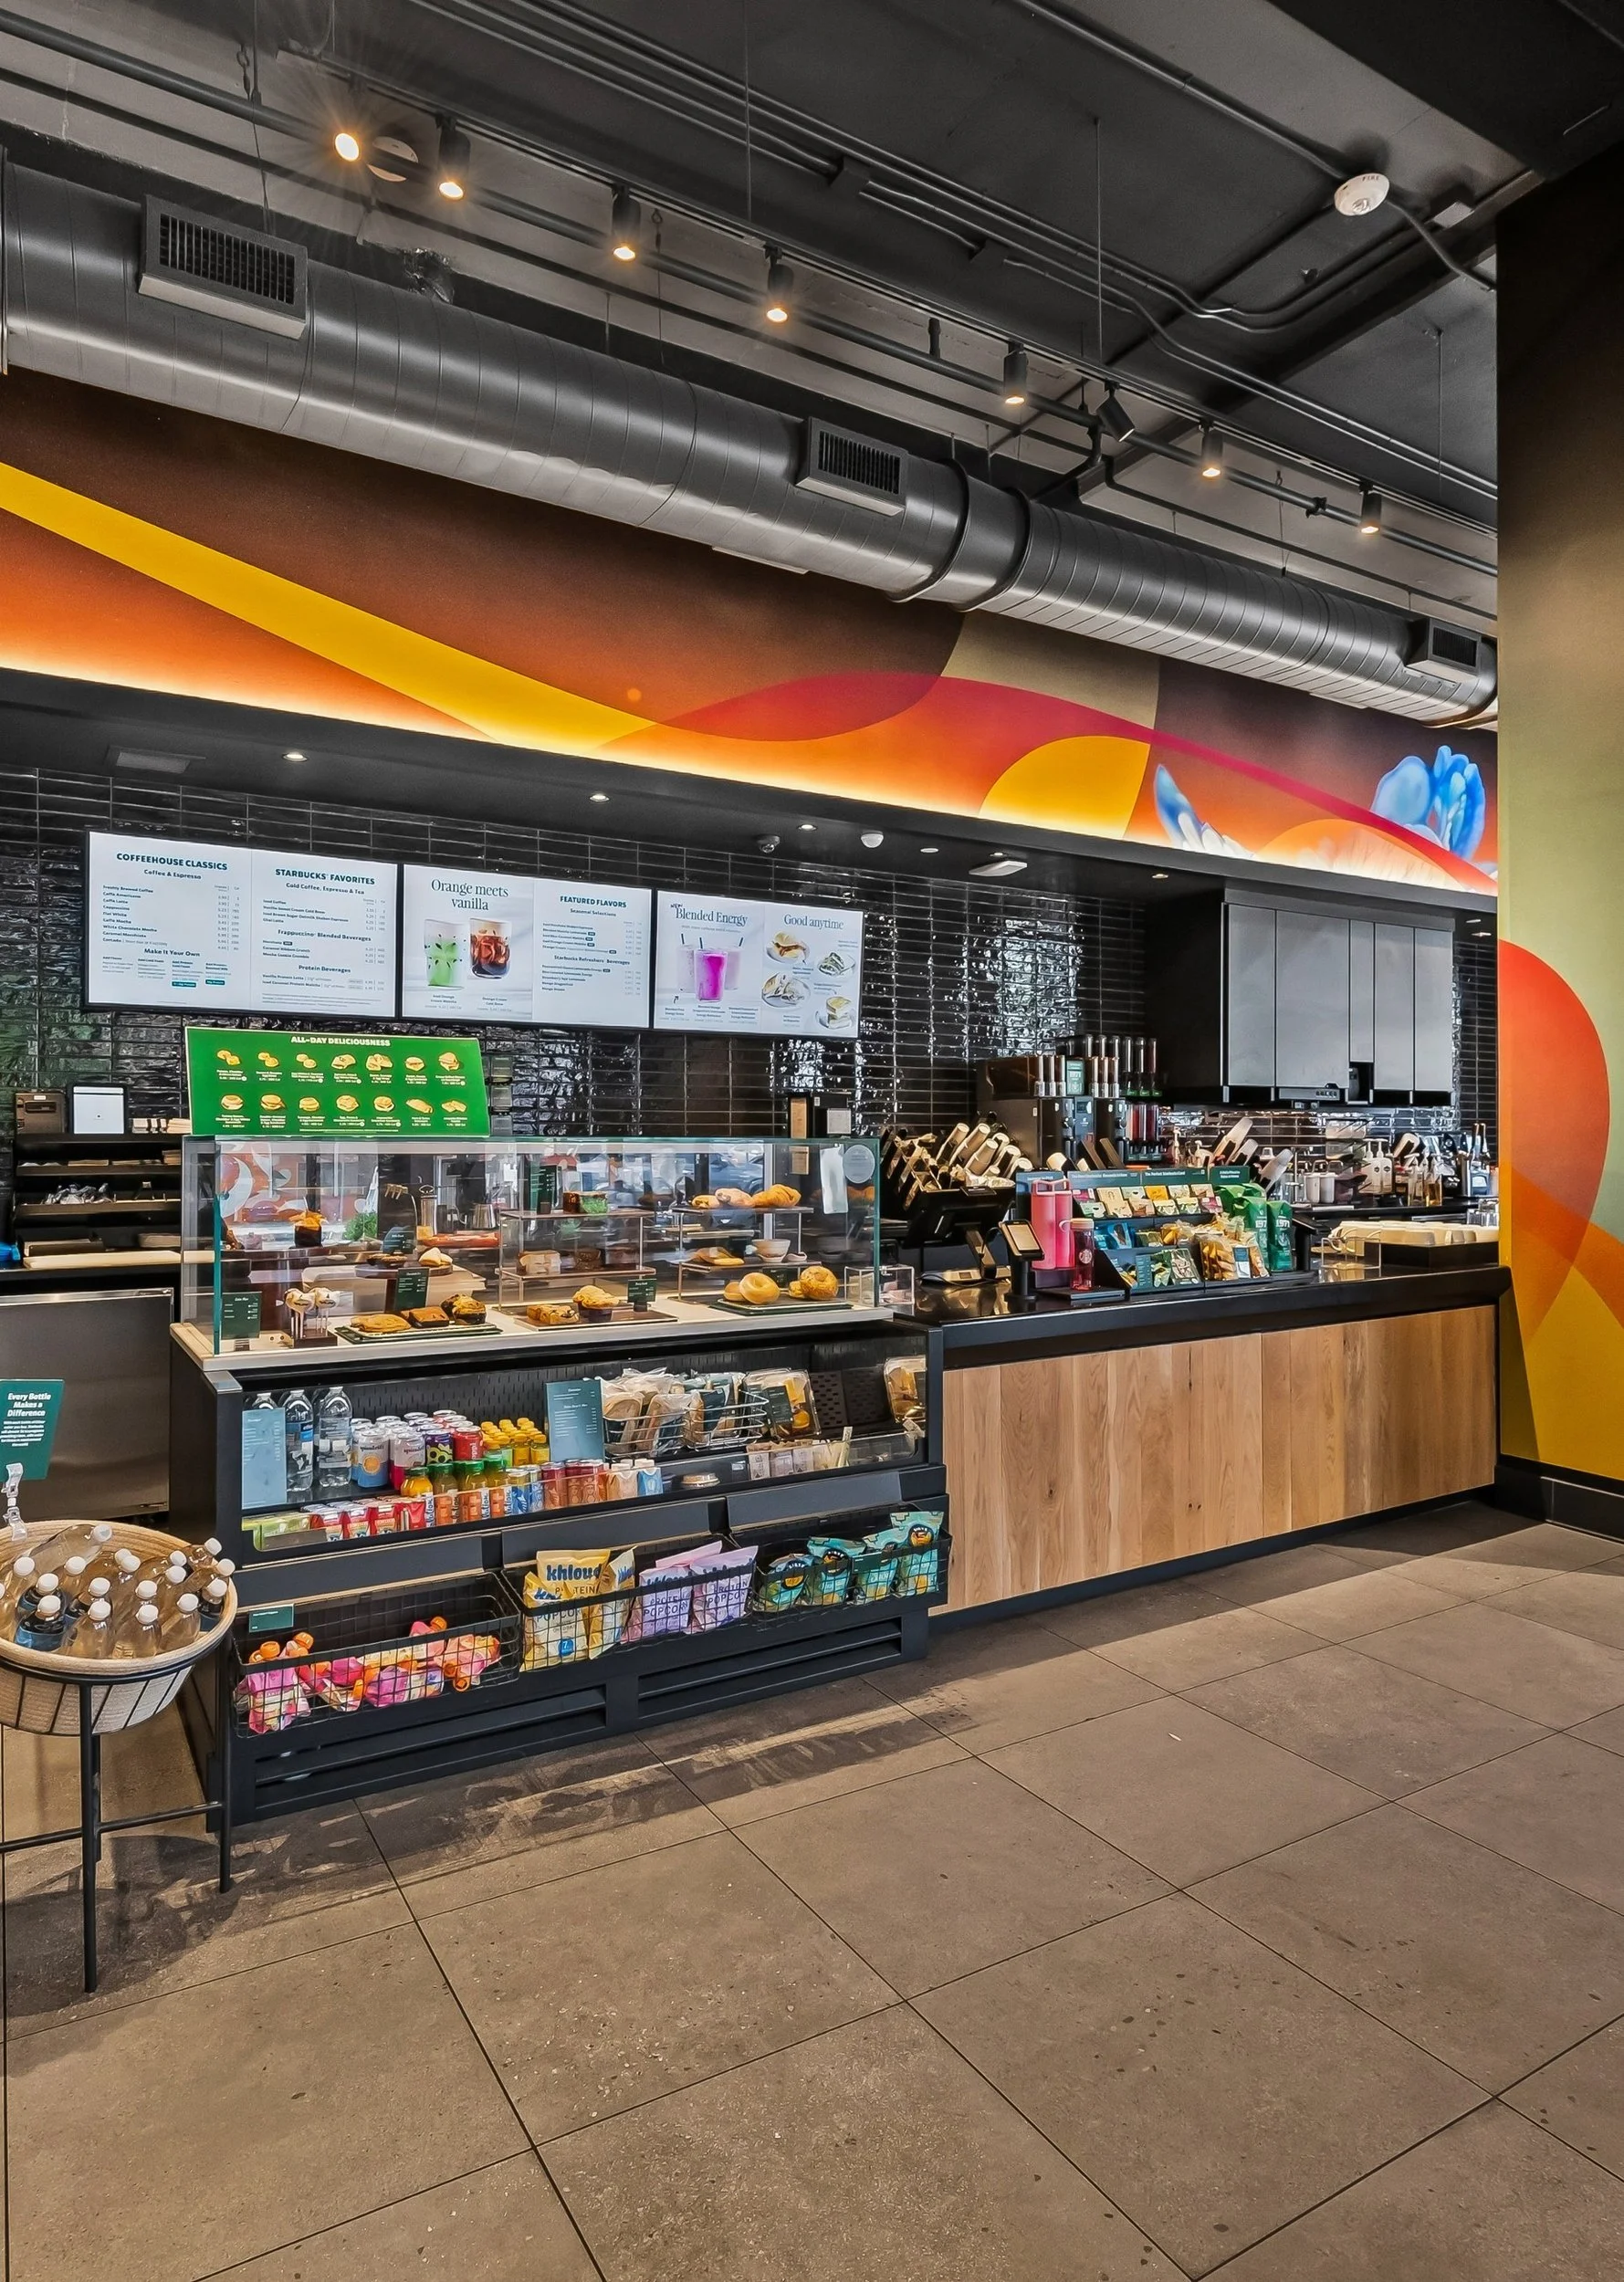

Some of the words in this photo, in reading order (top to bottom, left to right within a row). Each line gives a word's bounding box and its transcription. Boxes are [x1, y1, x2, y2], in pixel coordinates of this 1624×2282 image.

[116, 853, 183, 866] COFFEEHOUSE
[185, 860, 227, 870] CLASSICS
[173, 872, 202, 880] Espresso
[276, 868, 327, 880] STARBUCKS
[330, 874, 375, 885] FAVORITES
[322, 885, 348, 894] Espresso
[431, 879, 473, 896] Orange
[475, 885, 508, 898] meets
[451, 898, 489, 911] vanilla
[560, 895, 595, 905] FEATURED
[596, 899, 627, 908] FLAVORS
[676, 907, 714, 921] Blended
[716, 912, 748, 927] Energy
[784, 914, 807, 926] Good
[809, 916, 844, 930] anytime
[342, 934, 372, 942] Beverages
[290, 1036, 327, 1044] ALL-DAY
[328, 1037, 391, 1047] DELICIOUSNESS
[1255, 1220, 1267, 1228] 197
[7, 1392, 28, 1401] Every
[28, 1392, 52, 1400] Bottle
[6, 1409, 46, 1418] Difference
[555, 1586, 595, 1596] PTEIN
